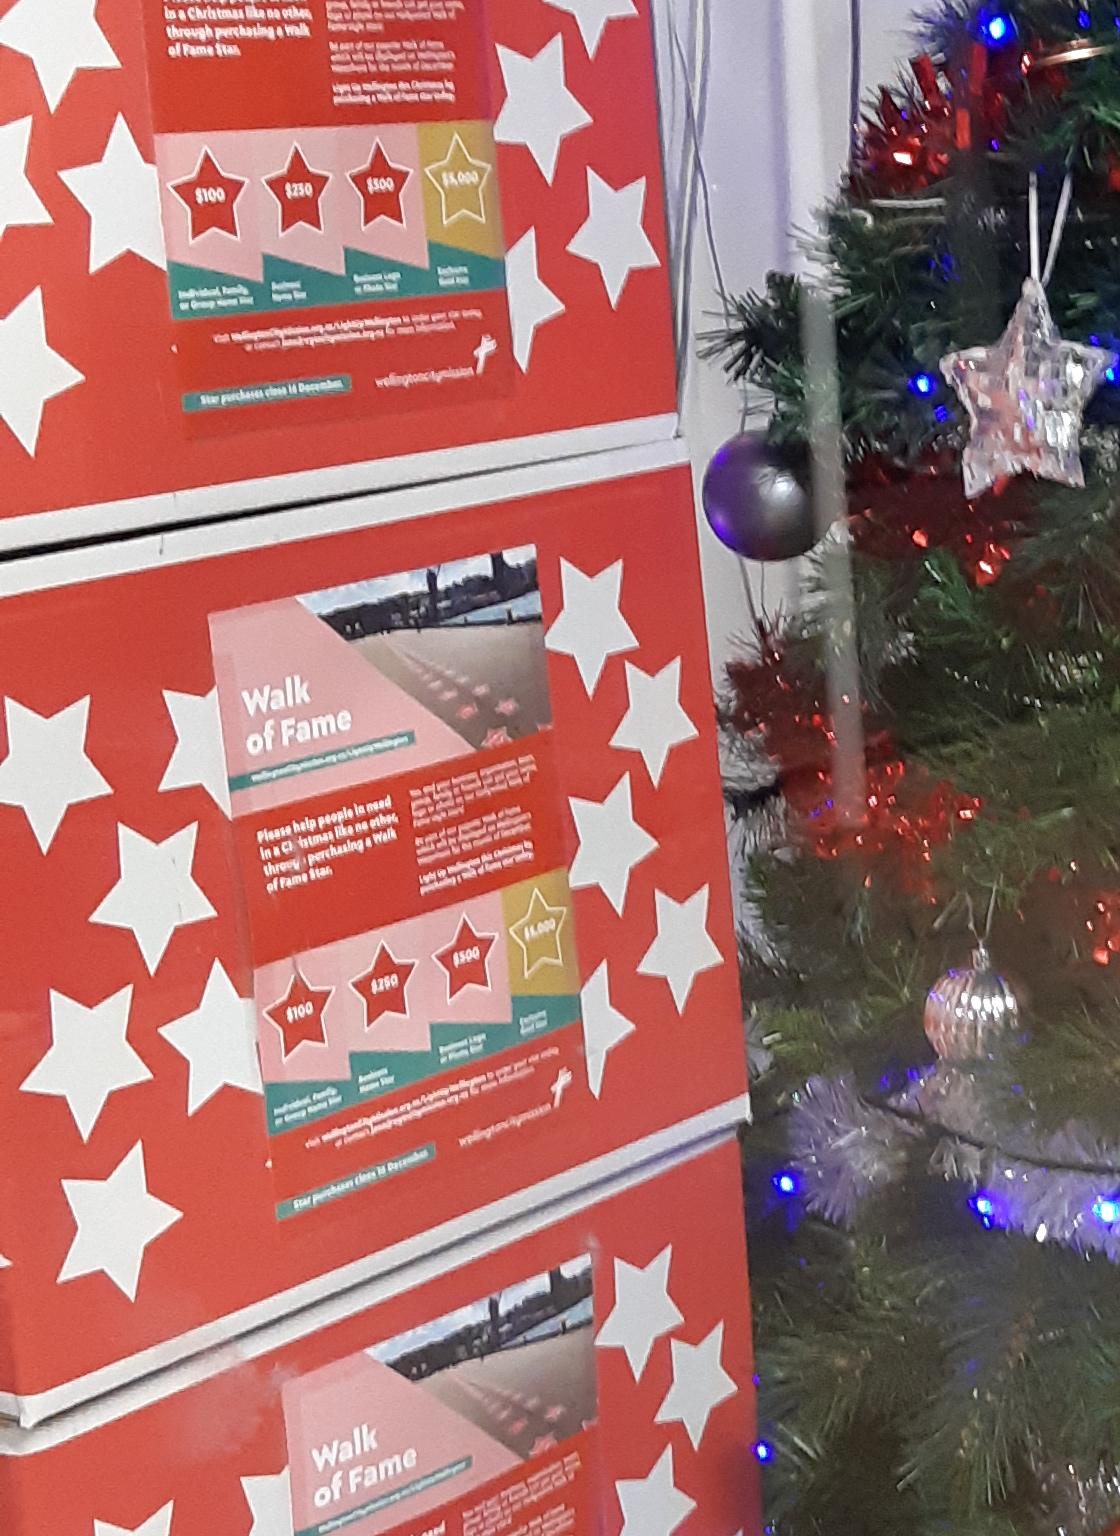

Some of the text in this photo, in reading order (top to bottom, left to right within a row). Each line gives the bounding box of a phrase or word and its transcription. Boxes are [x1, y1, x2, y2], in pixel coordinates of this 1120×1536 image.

[195, 187, 225, 205] $100
[241, 674, 312, 717] Walk
[246, 710, 352, 756] of Fame
[453, 946, 480, 968] $500
[286, 1001, 313, 1023] $100
[311, 1423, 378, 1473] Walk
[314, 1470, 343, 1508] of
[348, 1448, 417, 1494] Fame
